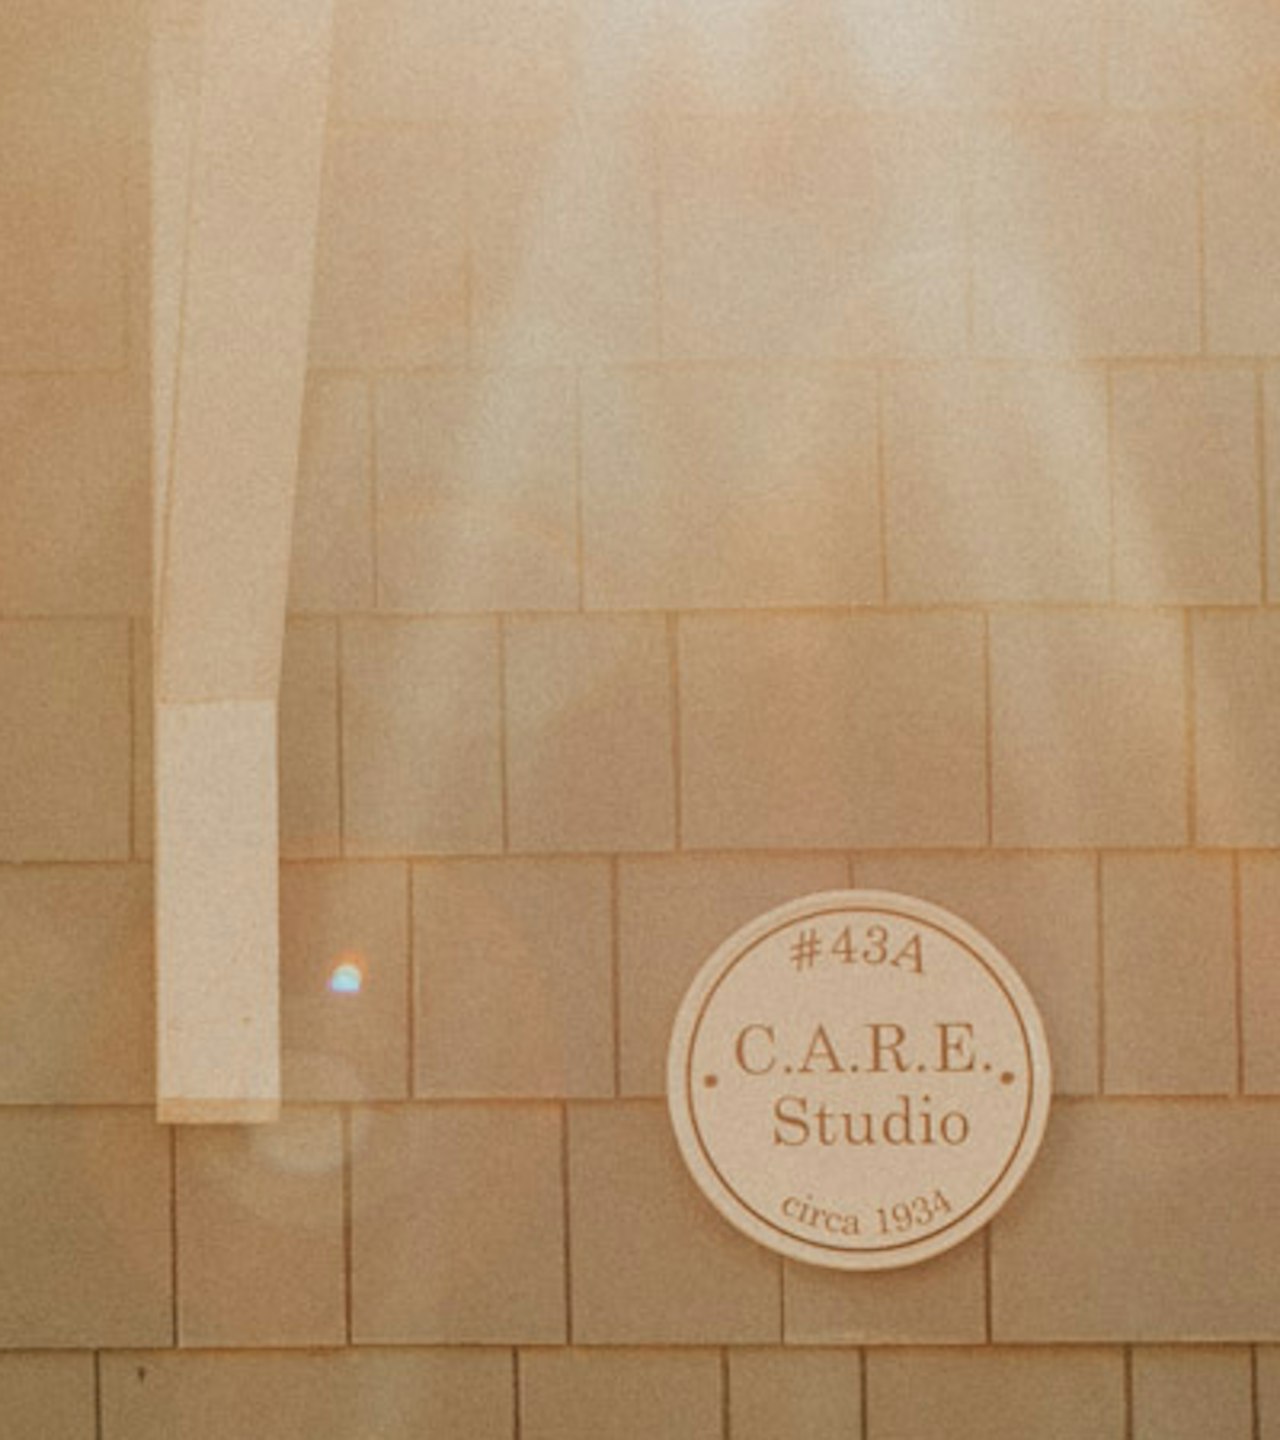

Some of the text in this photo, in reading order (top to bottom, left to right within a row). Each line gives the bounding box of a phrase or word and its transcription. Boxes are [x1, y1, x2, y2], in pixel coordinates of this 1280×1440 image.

[790, 924, 925, 974] #43A
[734, 1023, 992, 1075] C.A.R.E.
[773, 1095, 970, 1146] Studio
[781, 1189, 953, 1235] circa 1934
